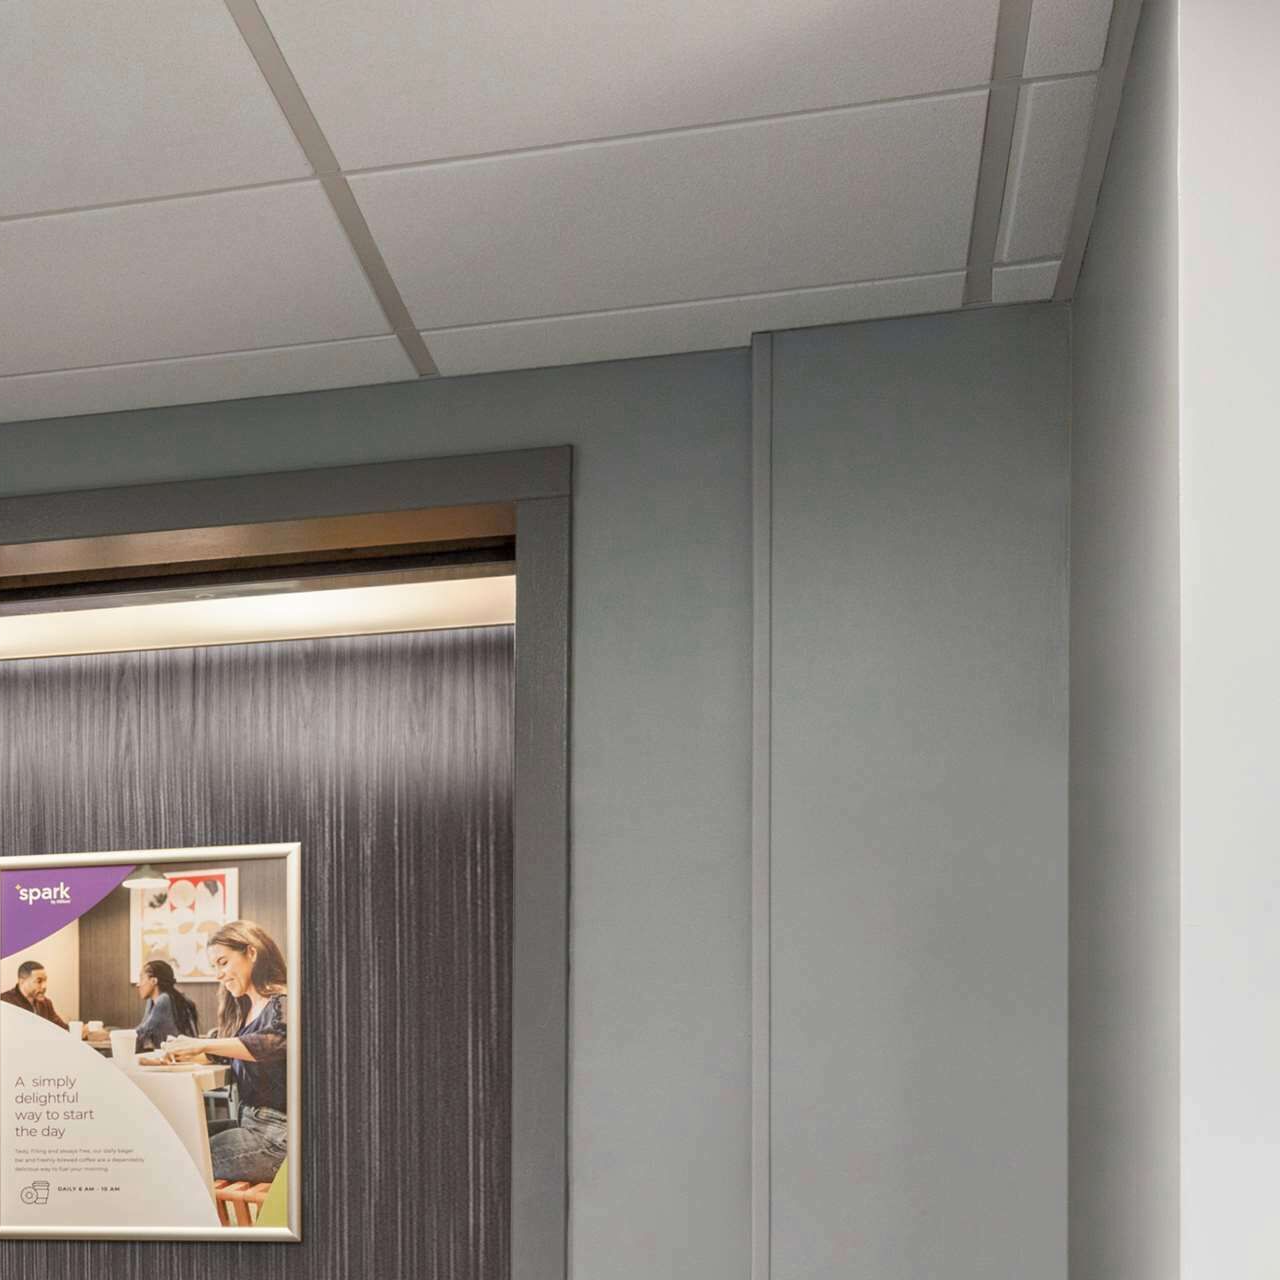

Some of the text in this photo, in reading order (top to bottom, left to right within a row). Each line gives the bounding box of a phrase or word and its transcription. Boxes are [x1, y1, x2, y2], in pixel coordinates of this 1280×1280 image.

[19, 882, 71, 905] spark
[15, 1075, 77, 1089] A simply
[15, 1092, 79, 1106] delightful
[15, 1109, 95, 1123] way to start
[15, 1125, 66, 1139] the day
